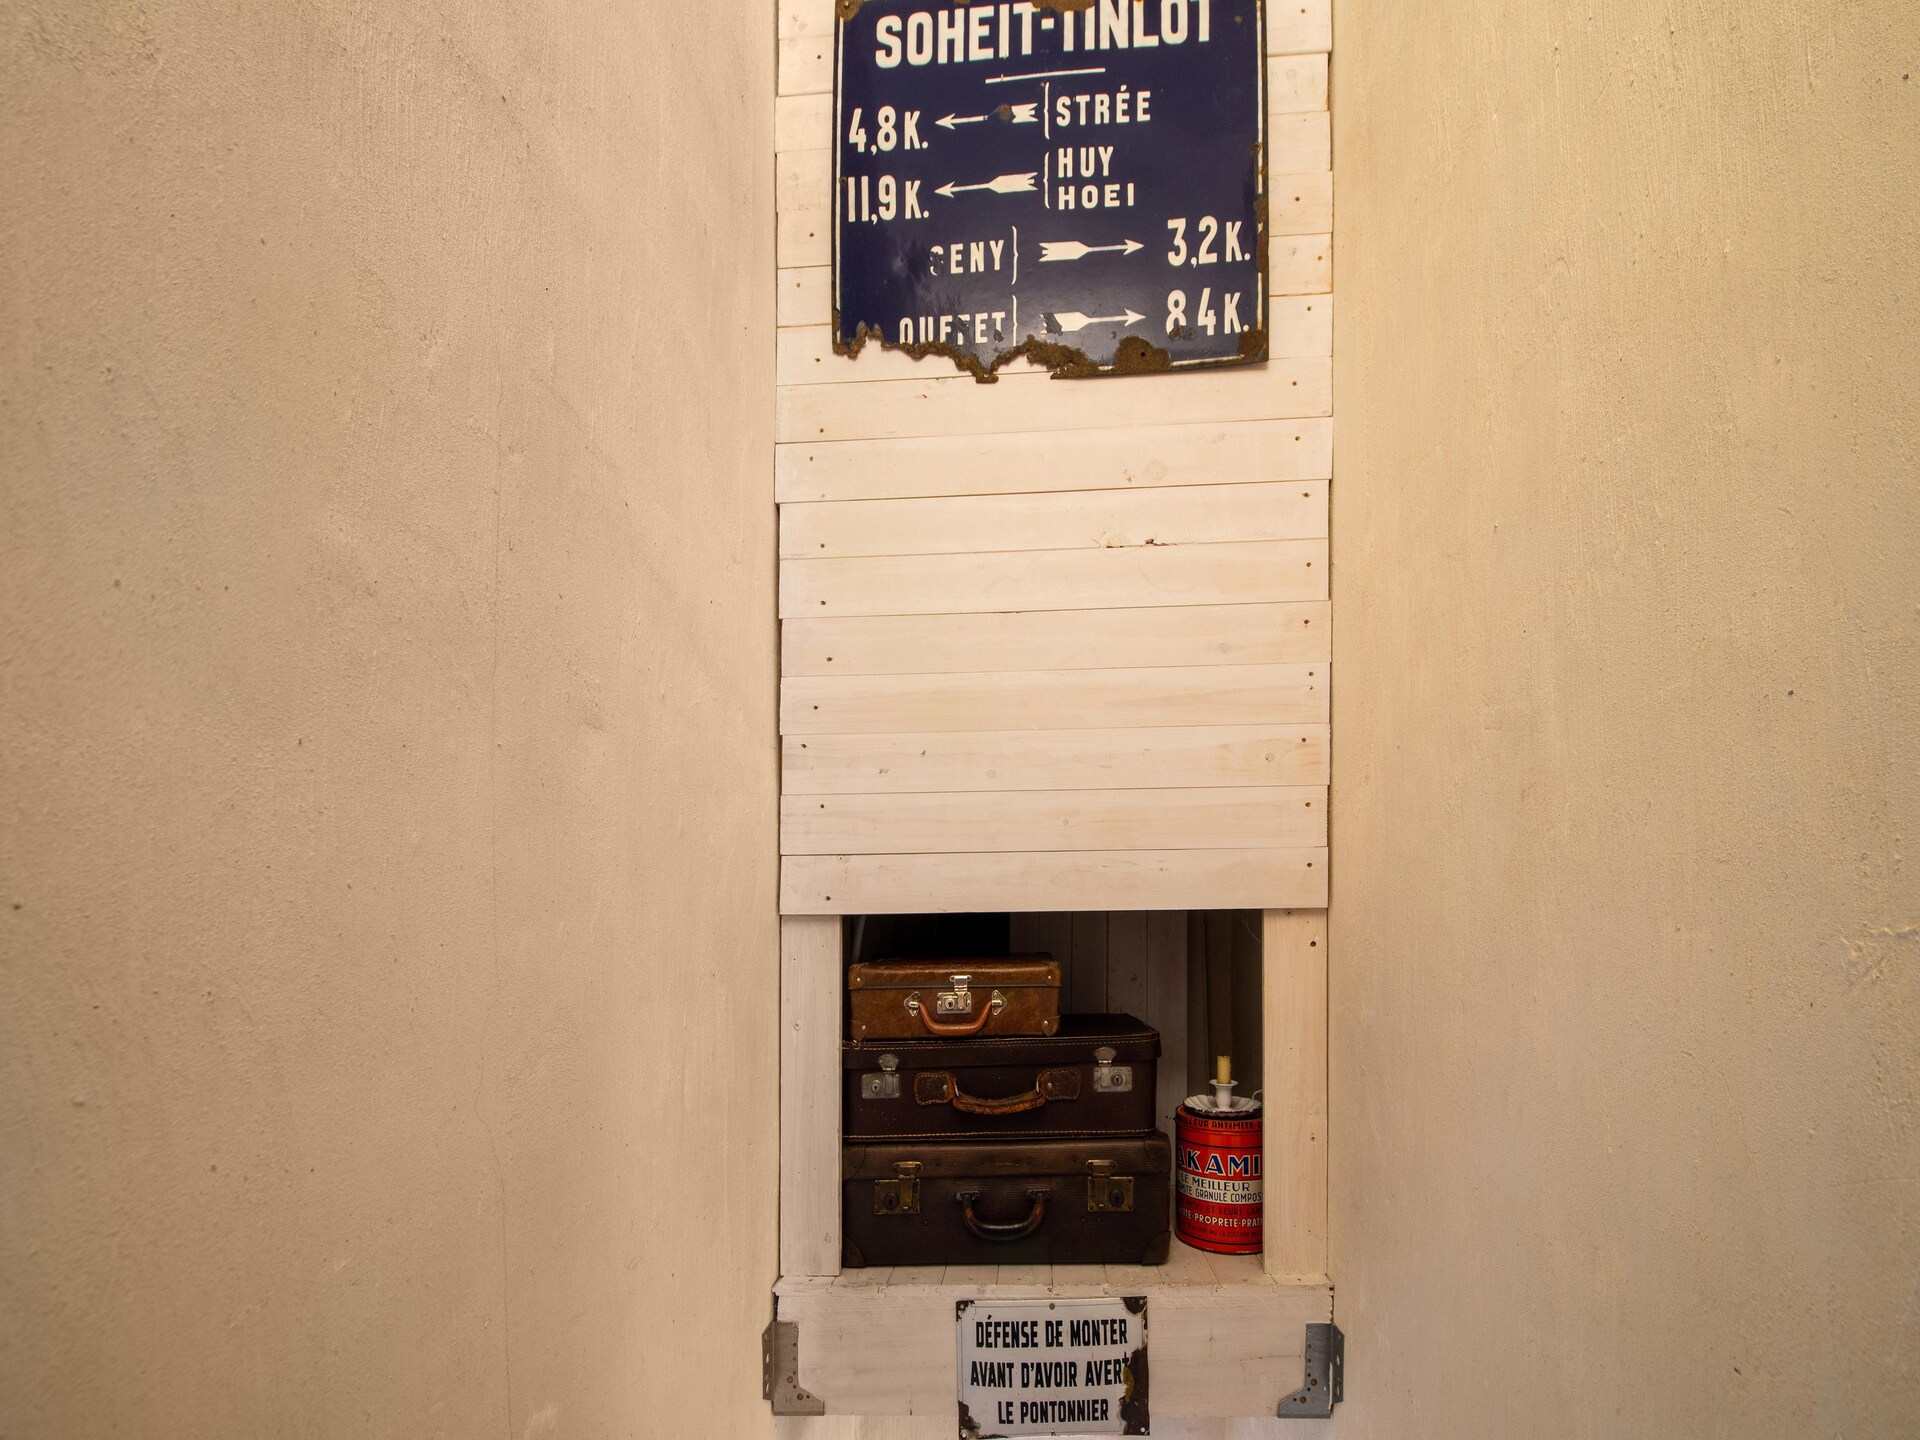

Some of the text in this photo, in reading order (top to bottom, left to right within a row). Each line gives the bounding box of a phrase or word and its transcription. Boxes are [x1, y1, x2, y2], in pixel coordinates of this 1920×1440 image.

[1055, 85, 1152, 127] STRÉE
[1058, 146, 1114, 178] HUY
[1058, 182, 1135, 210] HOEI
[1211, 1120, 1254, 1130] ANTIMITE
[1181, 1172, 1250, 1192] LE MEILLEUR
[1195, 1188, 1228, 1203] GRANULÉ
[975, 1314, 1128, 1349] DÉFENSE DE MONTER
[970, 1360, 1015, 1389] AVANT
[1021, 1360, 1078, 1389] D'AVOIR
[997, 1399, 1109, 1425] LE PONTONNIER
